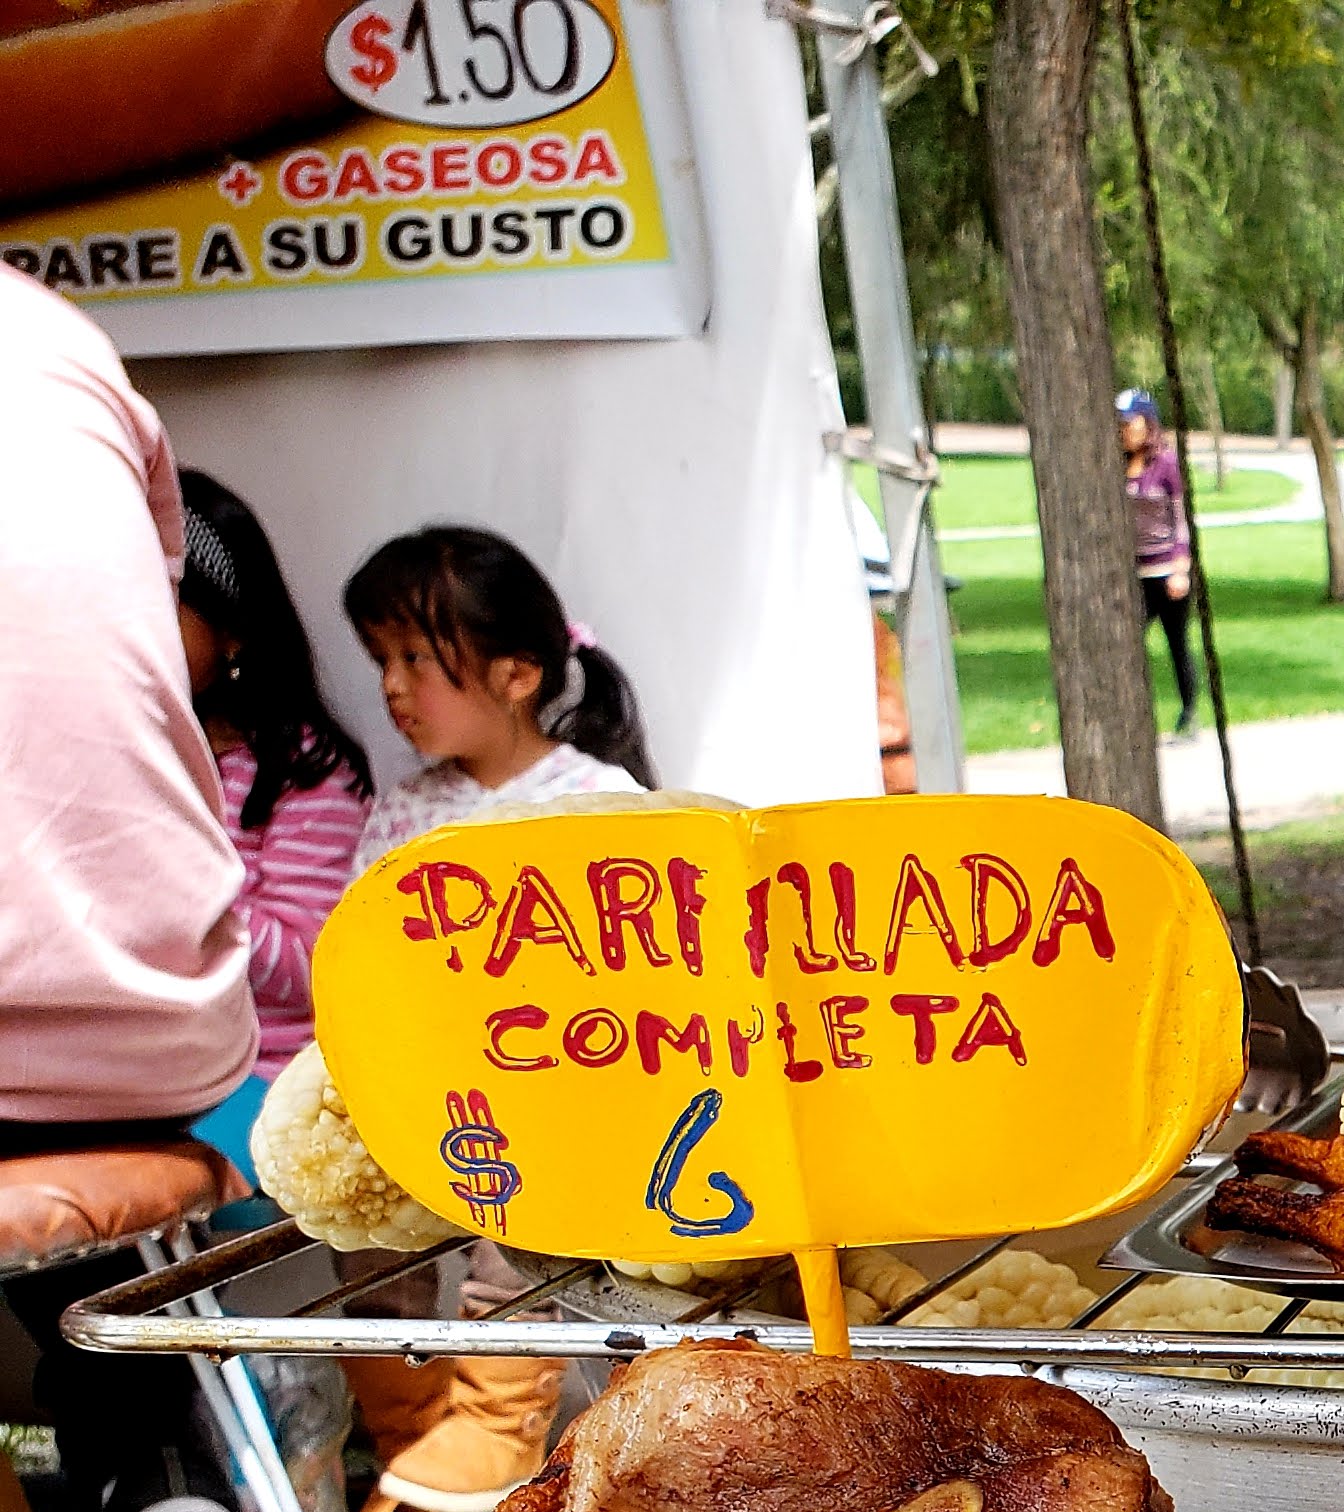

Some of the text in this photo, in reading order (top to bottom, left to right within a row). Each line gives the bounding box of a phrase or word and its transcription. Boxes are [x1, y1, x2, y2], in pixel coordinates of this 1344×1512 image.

[350, 0, 579, 104] $1.50
[281, 133, 617, 201] GASEOSA
[201, 231, 246, 277] A
[267, 219, 361, 271] SU
[386, 204, 626, 262] GUSTO
[483, 992, 1027, 1083] COMPLETA
[646, 1088, 754, 1237] 6
